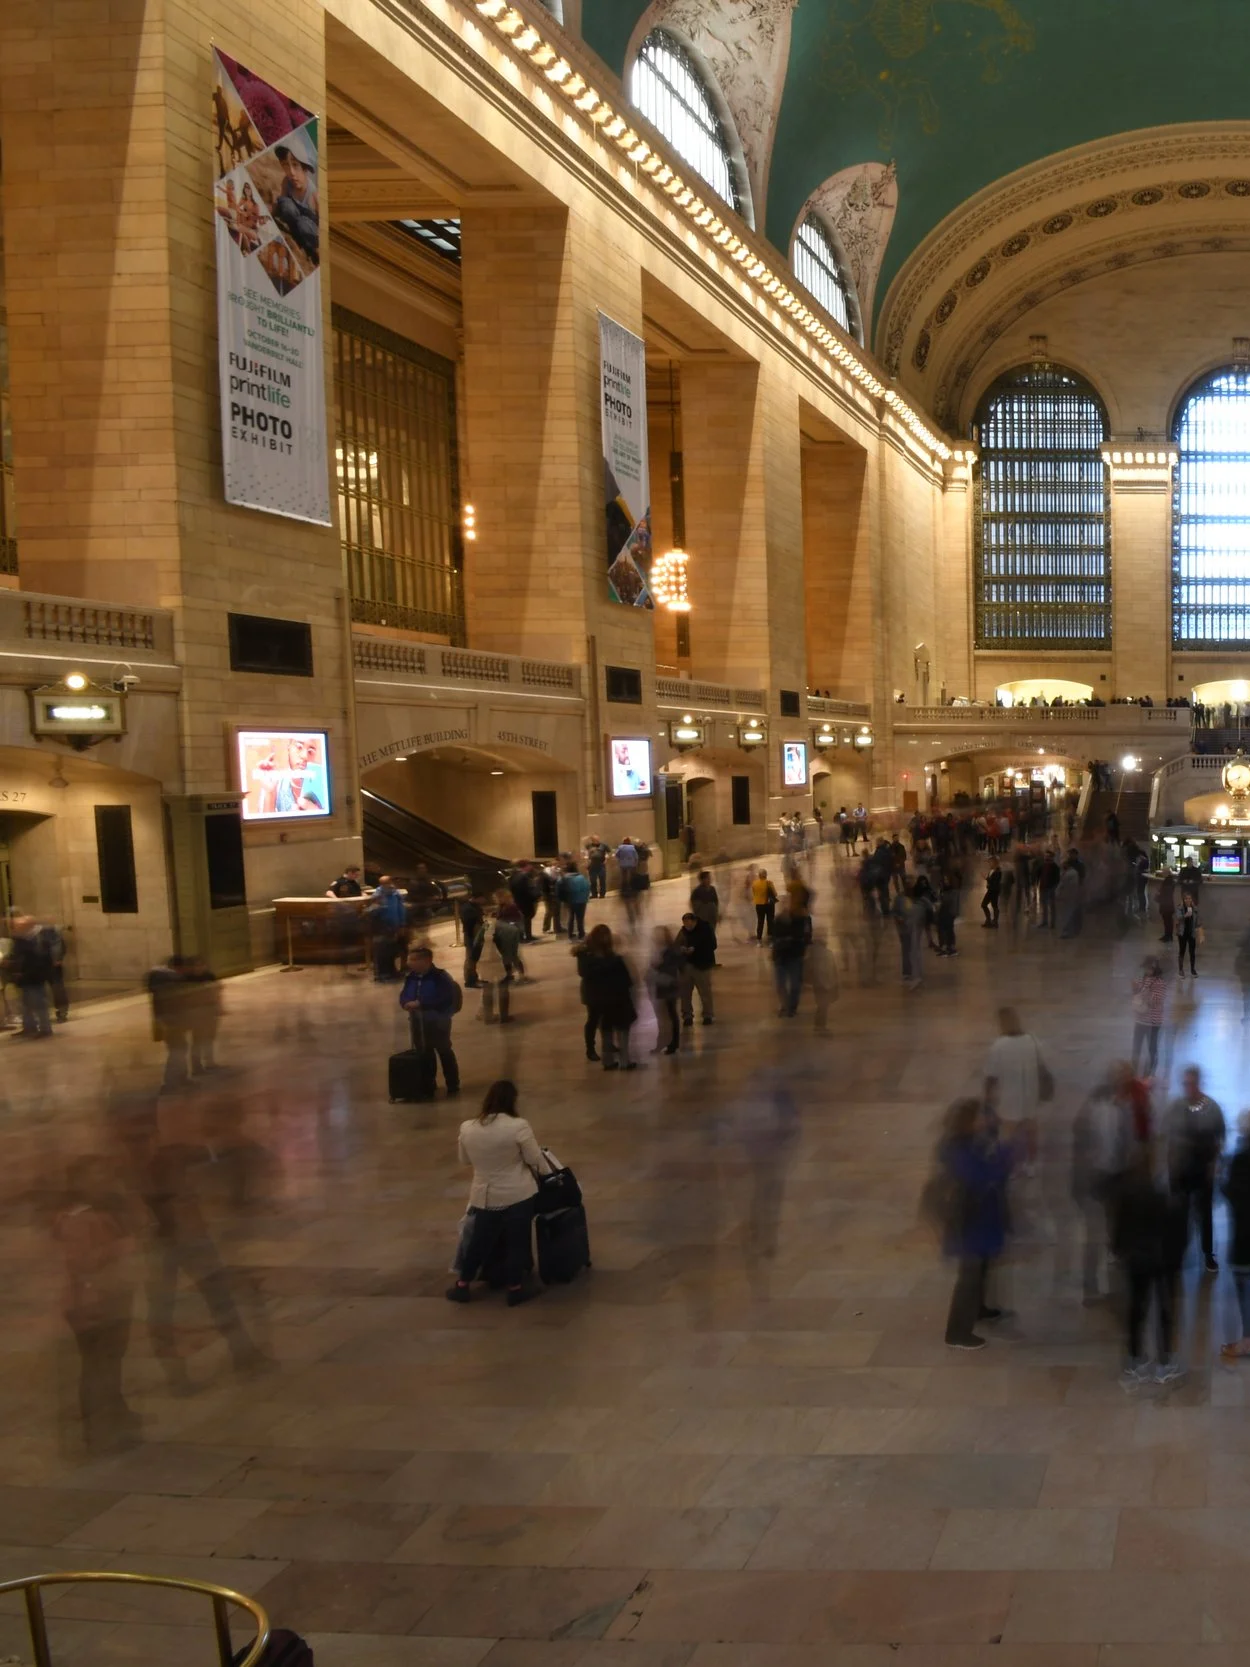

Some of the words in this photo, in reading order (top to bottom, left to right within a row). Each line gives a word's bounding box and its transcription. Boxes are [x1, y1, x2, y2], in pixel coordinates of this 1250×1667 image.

[260, 294, 300, 320] MEMORIES
[248, 329, 279, 347] OCTOBER
[257, 316, 268, 328] TO
[269, 322, 290, 338] LIFE!
[229, 352, 290, 388] FUJIFILM
[230, 374, 290, 408] printlife
[604, 392, 632, 418] PHOTO
[231, 402, 292, 439] PHOTO
[232, 426, 292, 455] EXHIBIT
[378, 735, 421, 758] METLIFE
[424, 728, 468, 744] BUILDING
[497, 731, 518, 744] 45TH
[519, 735, 550, 751] STREET
[12, 792, 27, 804] 27
